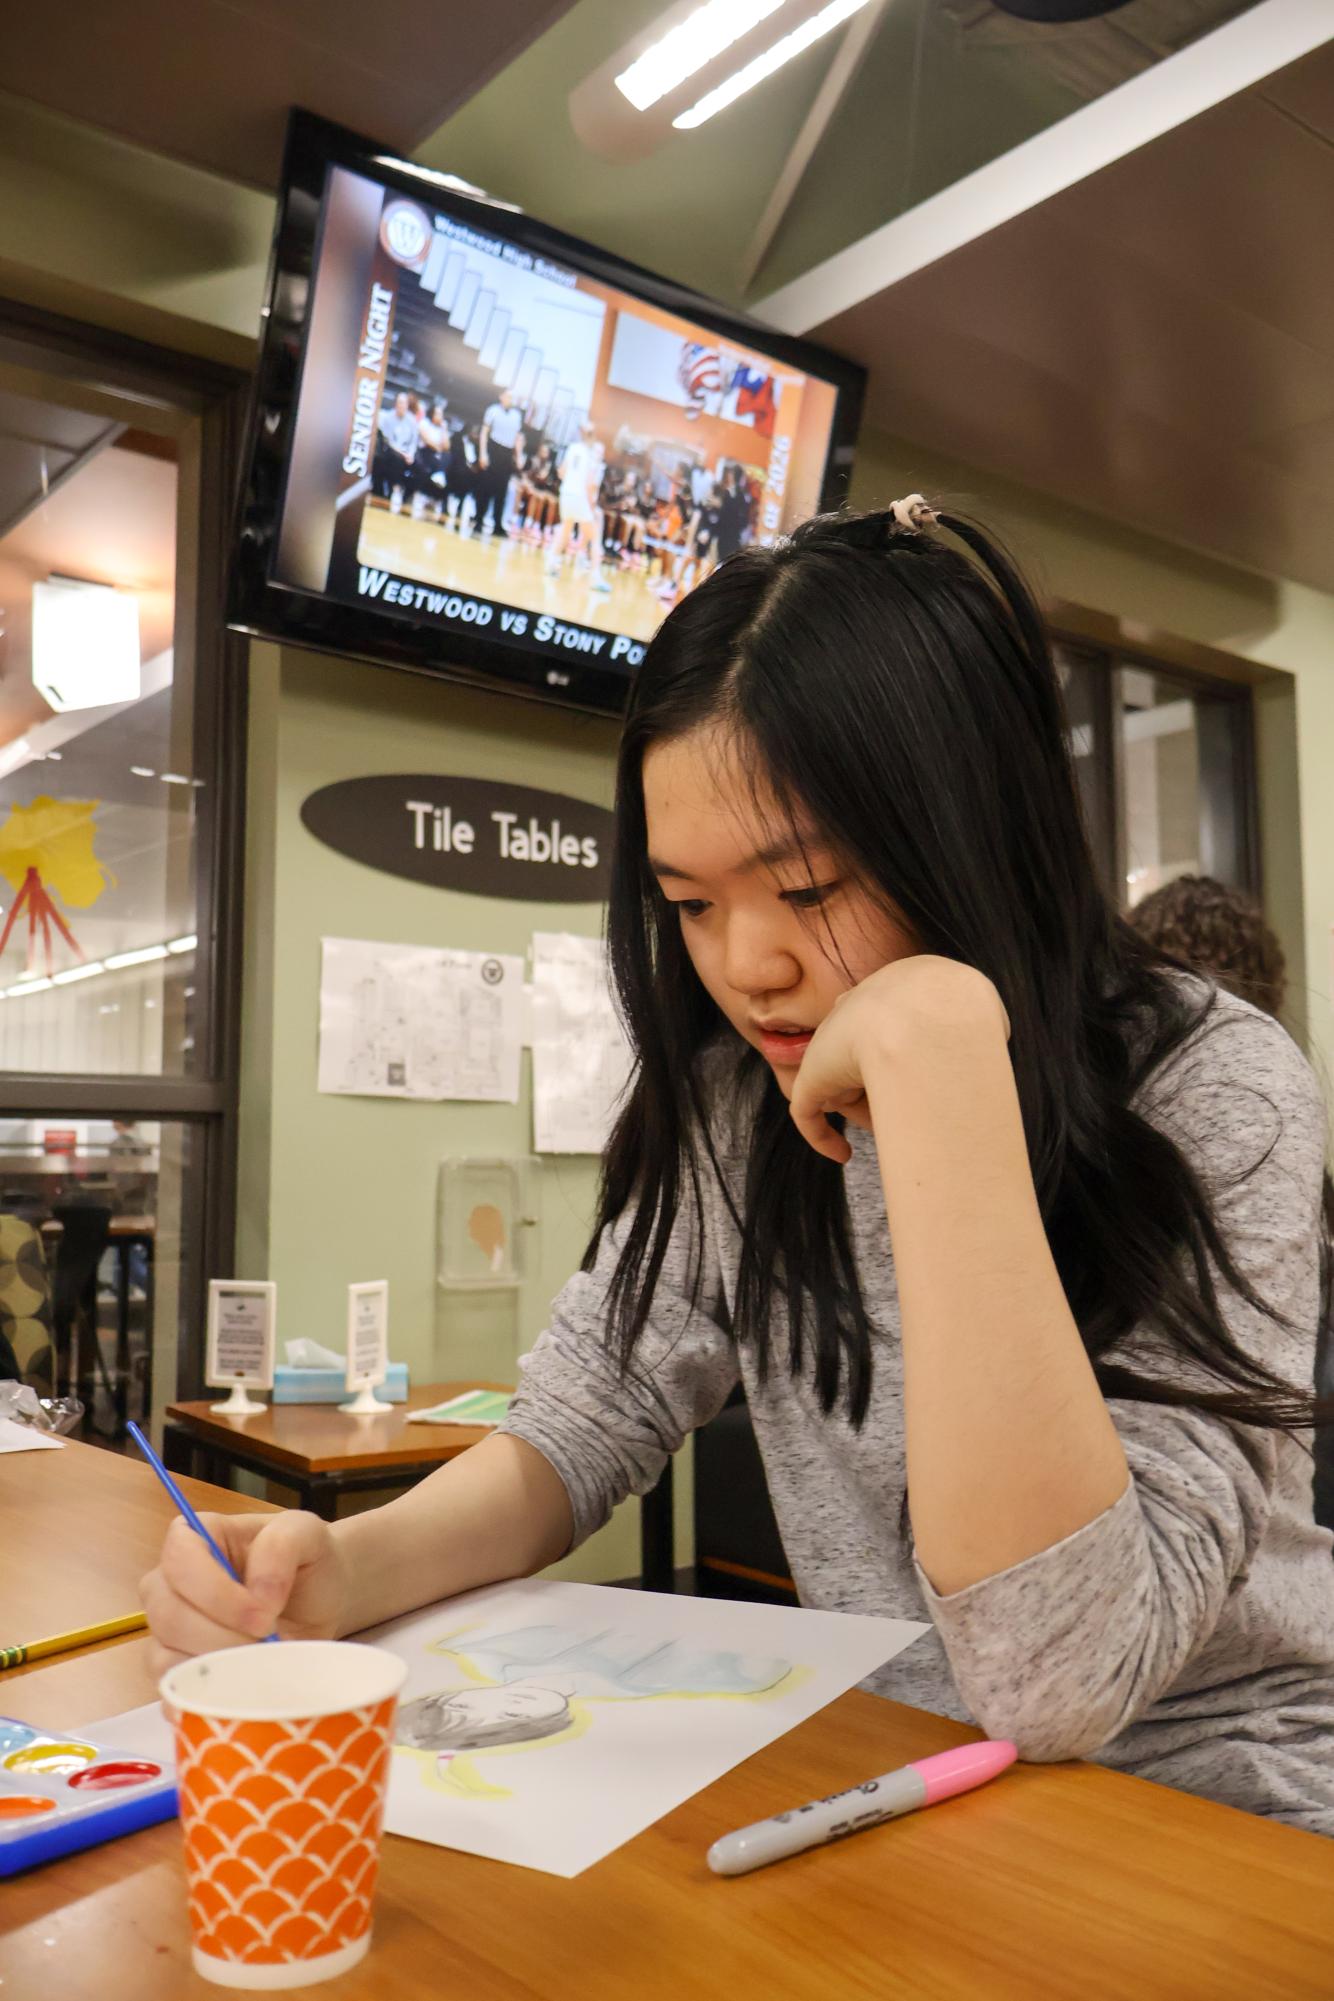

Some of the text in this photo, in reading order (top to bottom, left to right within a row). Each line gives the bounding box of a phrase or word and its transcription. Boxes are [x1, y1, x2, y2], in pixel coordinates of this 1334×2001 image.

[434, 214, 577, 289] Westwood High School
[357, 565, 493, 627] WESTWOOD
[610, 634, 646, 666] PO
[406, 800, 599, 868] Tile Tables
